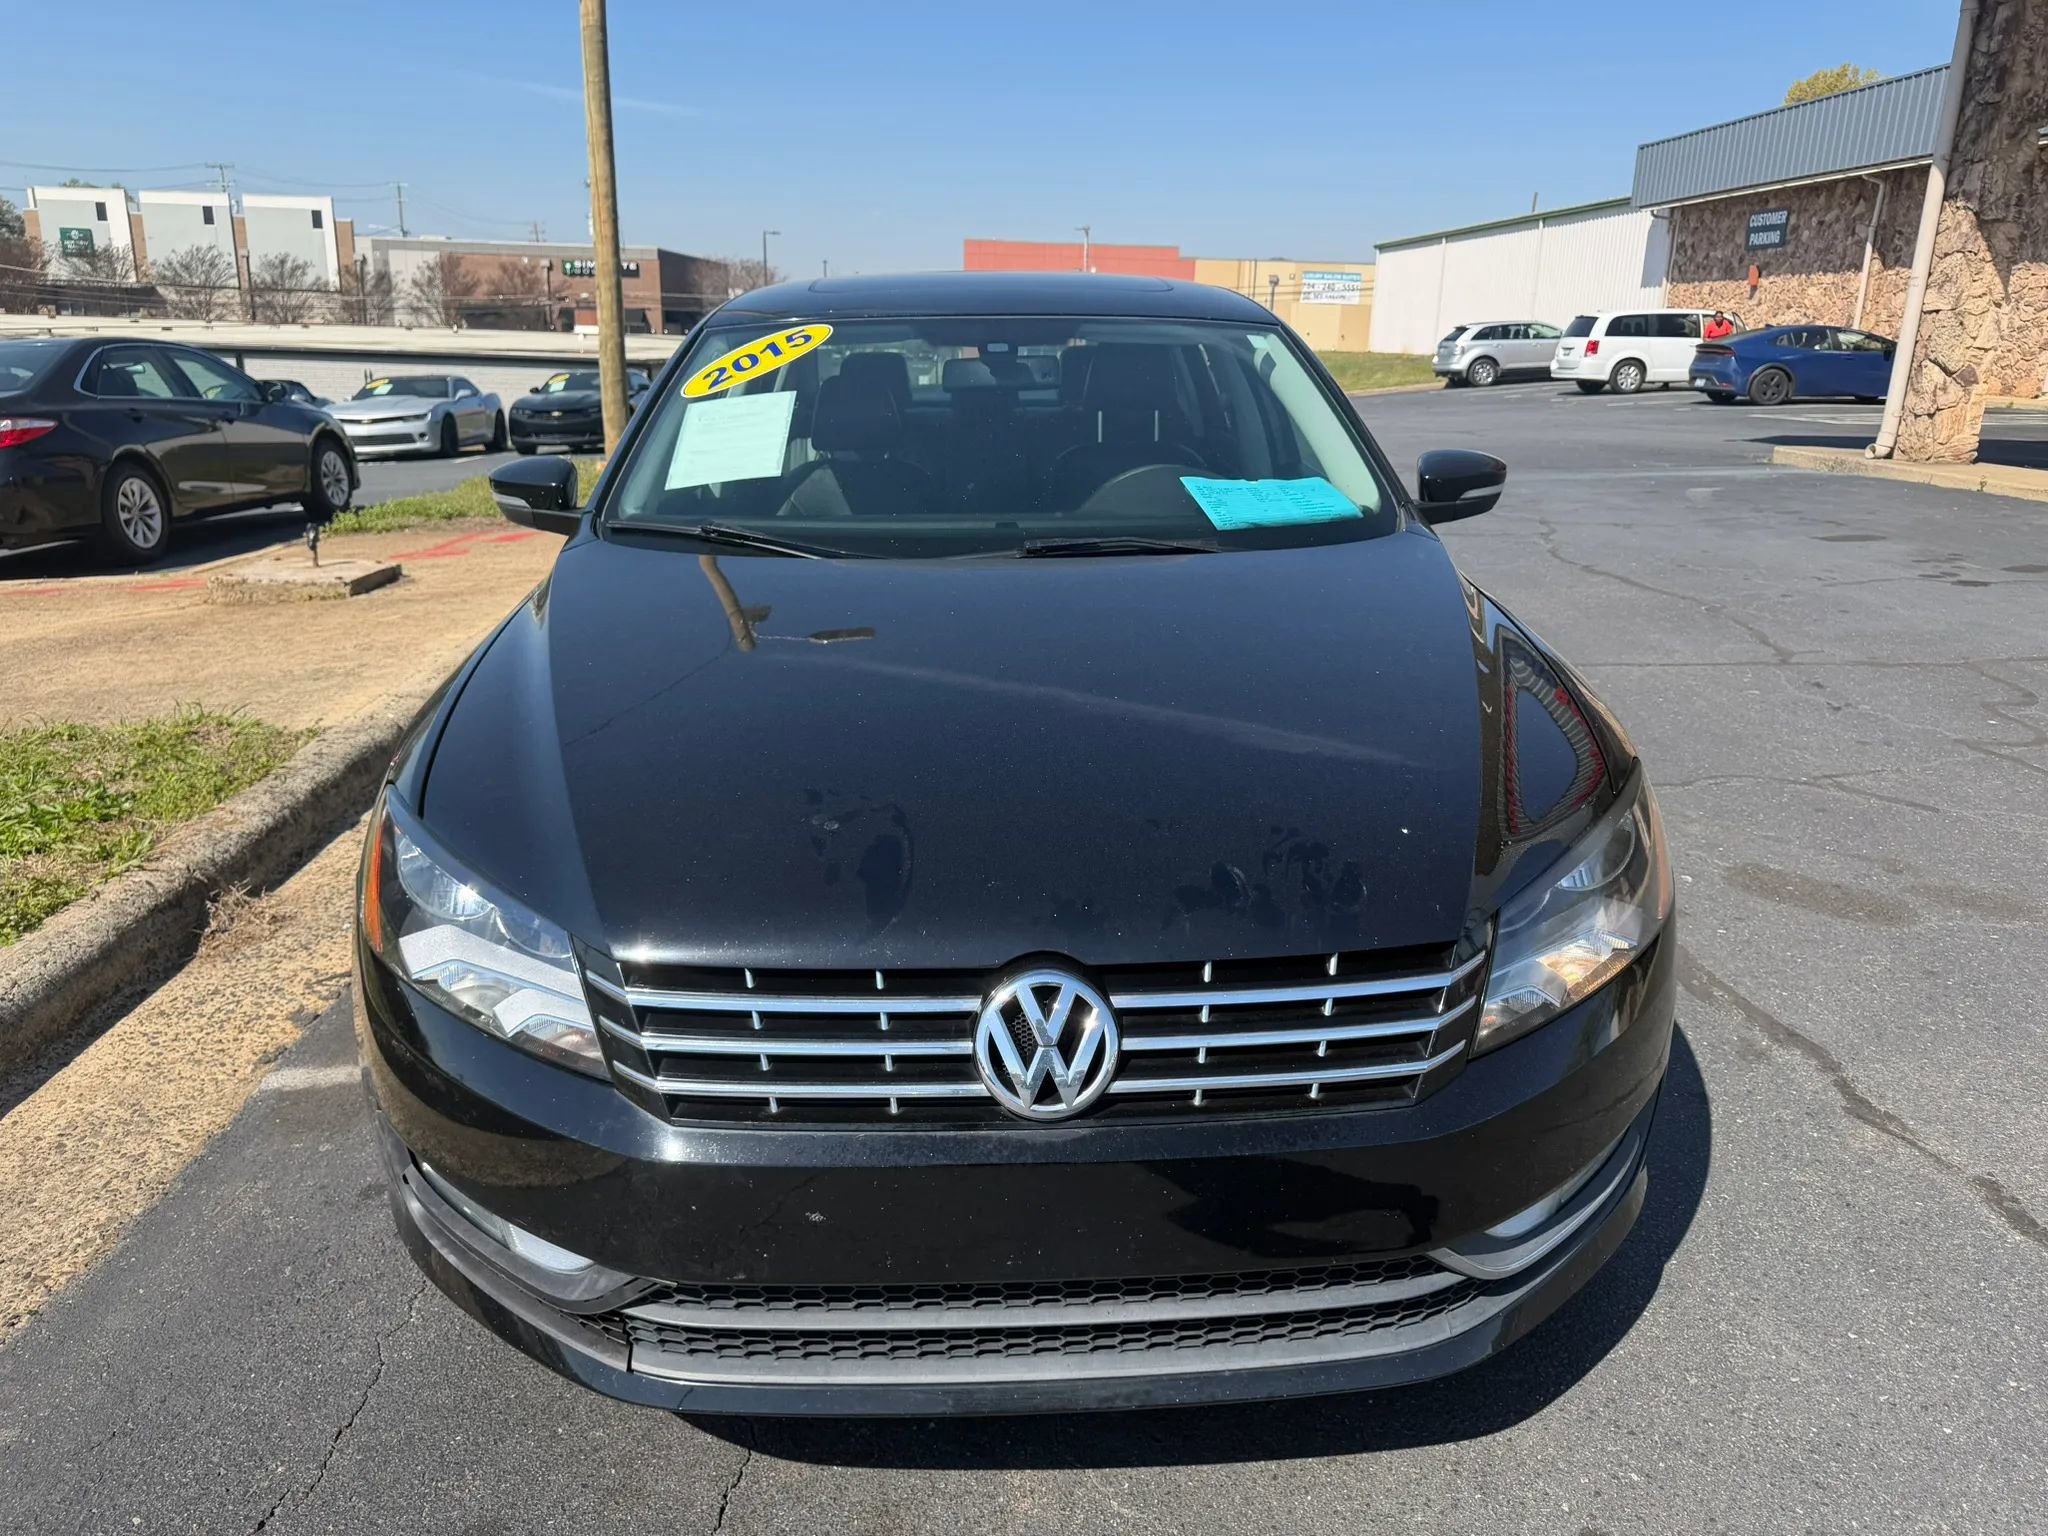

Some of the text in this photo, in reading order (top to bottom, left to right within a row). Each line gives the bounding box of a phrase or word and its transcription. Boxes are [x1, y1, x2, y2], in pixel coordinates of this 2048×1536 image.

[1749, 210, 1788, 228] CUSTOMER
[1748, 230, 1781, 246] PARKING
[702, 329, 814, 390] 2015
